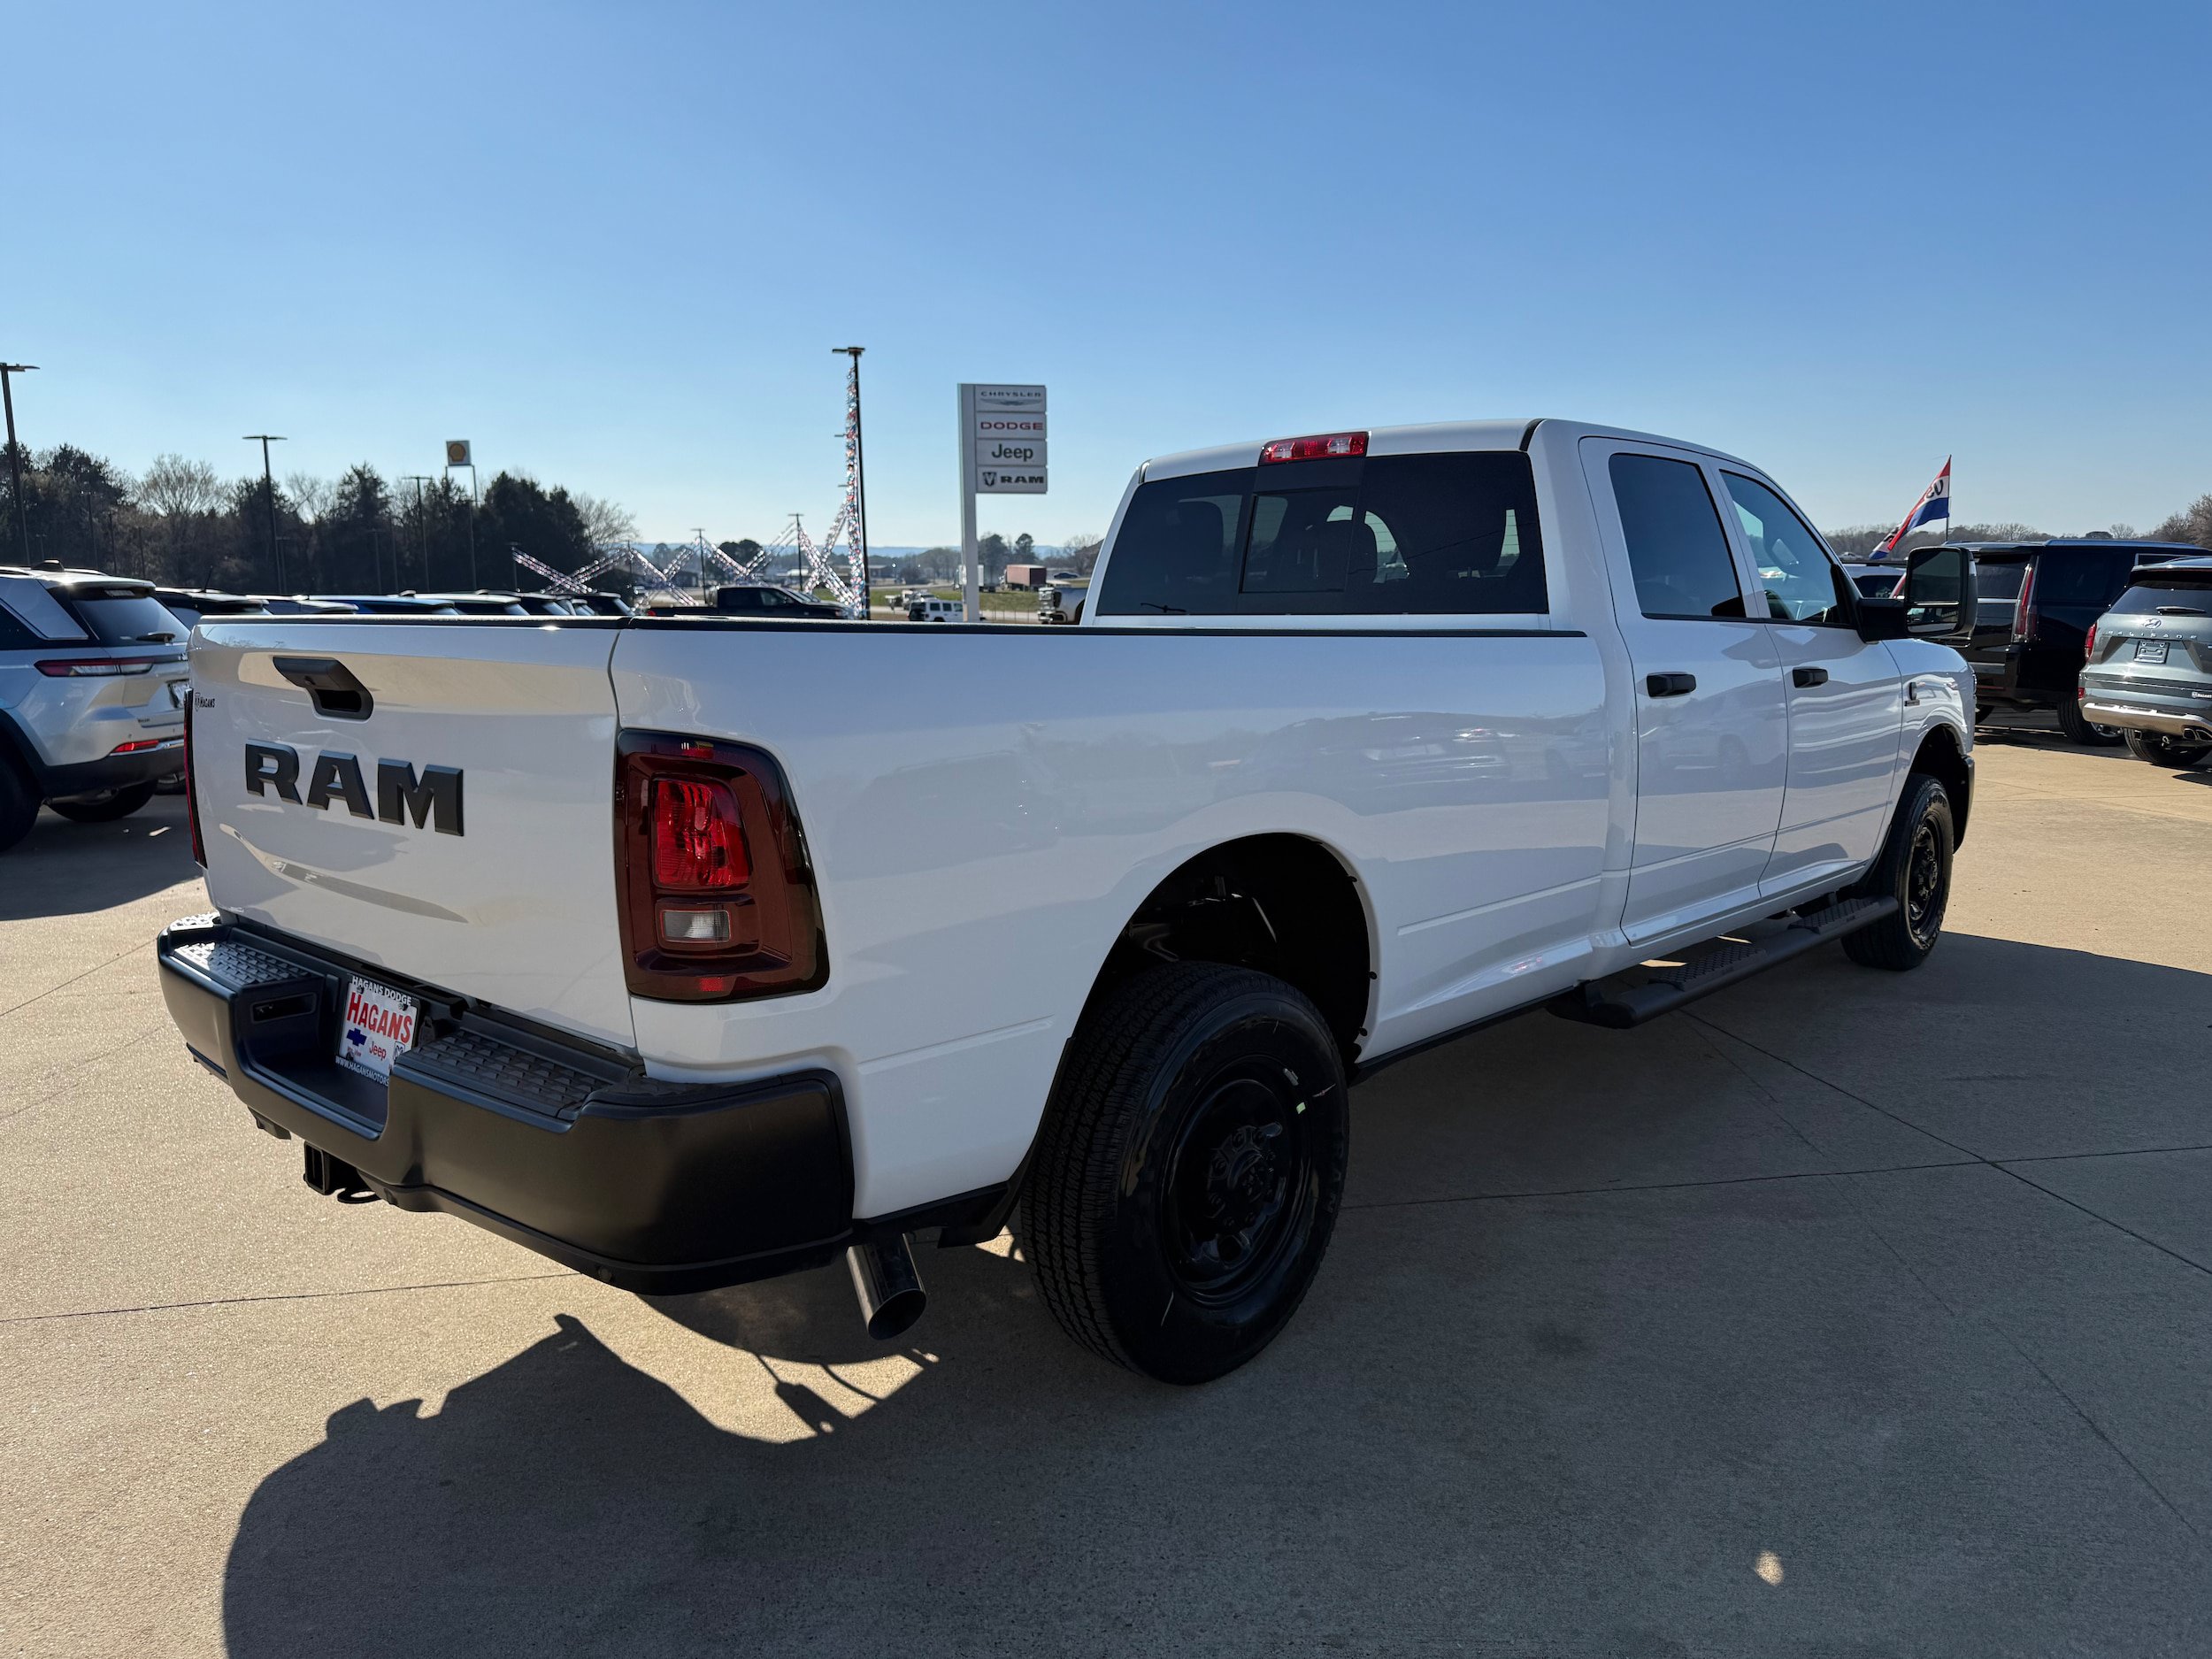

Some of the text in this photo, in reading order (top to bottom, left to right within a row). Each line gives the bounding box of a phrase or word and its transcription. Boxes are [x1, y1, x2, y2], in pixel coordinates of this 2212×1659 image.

[980, 421, 1043, 430] DODGE
[991, 443, 1033, 461] Jeep
[244, 738, 465, 837] RAM
[351, 976, 412, 1006] HAGANS DODGE
[346, 992, 413, 1043] HAGANS
[369, 1041, 387, 1061] Jeep
